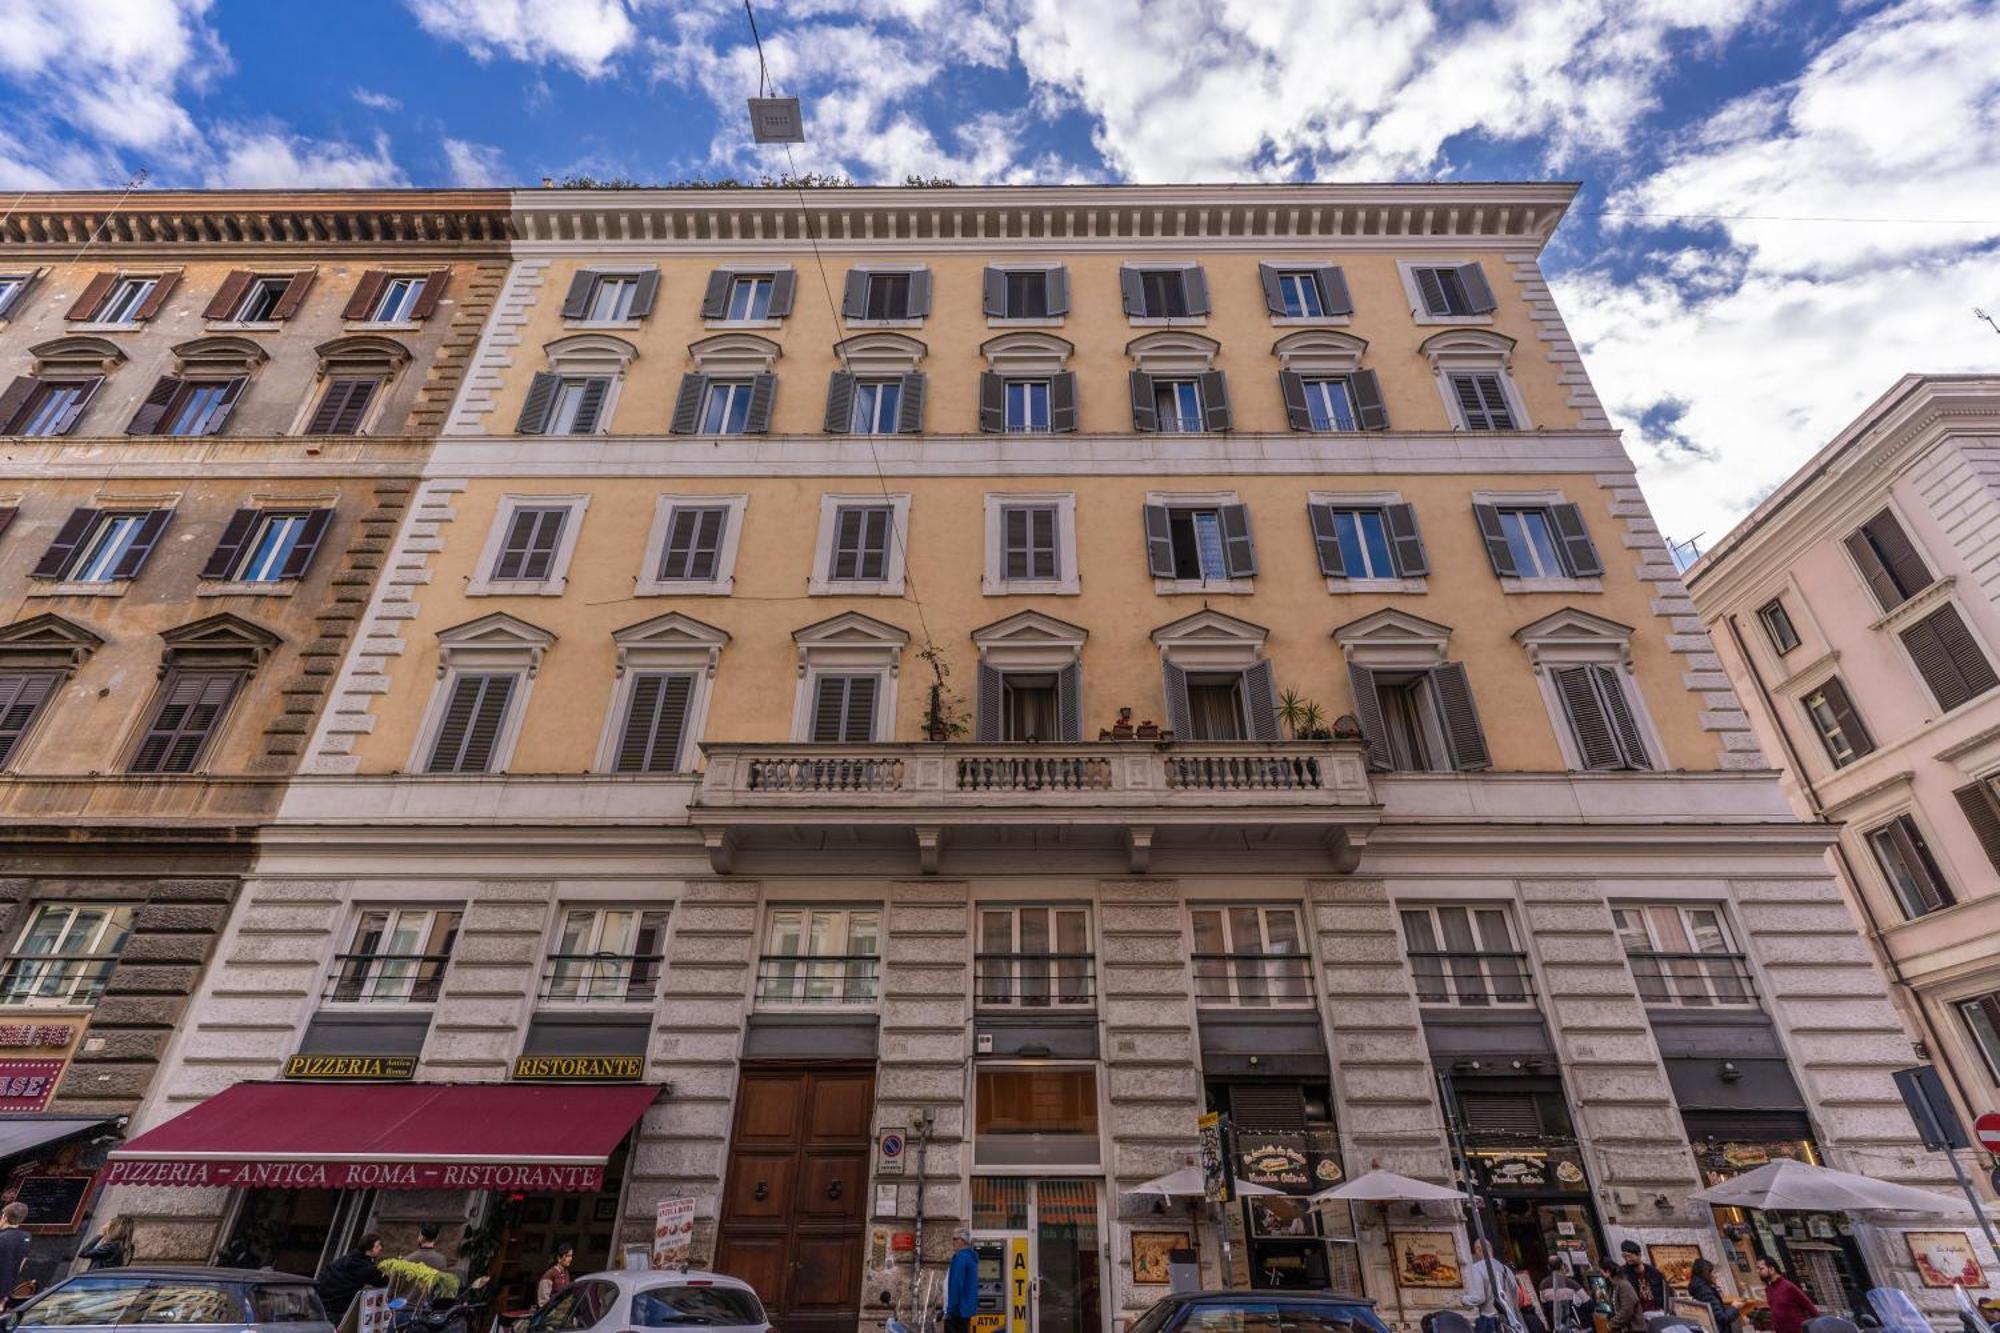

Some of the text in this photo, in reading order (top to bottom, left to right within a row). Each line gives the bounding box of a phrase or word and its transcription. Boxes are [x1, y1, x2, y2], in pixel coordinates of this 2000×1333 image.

[289, 1058, 381, 1074] PIZZERIA
[517, 1059, 639, 1075] RISTORANTE
[107, 1162, 208, 1181] PIZZERIA
[232, 1164, 326, 1183] ANTICA
[346, 1164, 417, 1184] ROMA
[443, 1166, 596, 1186] RISTORANTE
[1014, 1252, 1026, 1321] ATM
[977, 1317, 999, 1326] ATM
